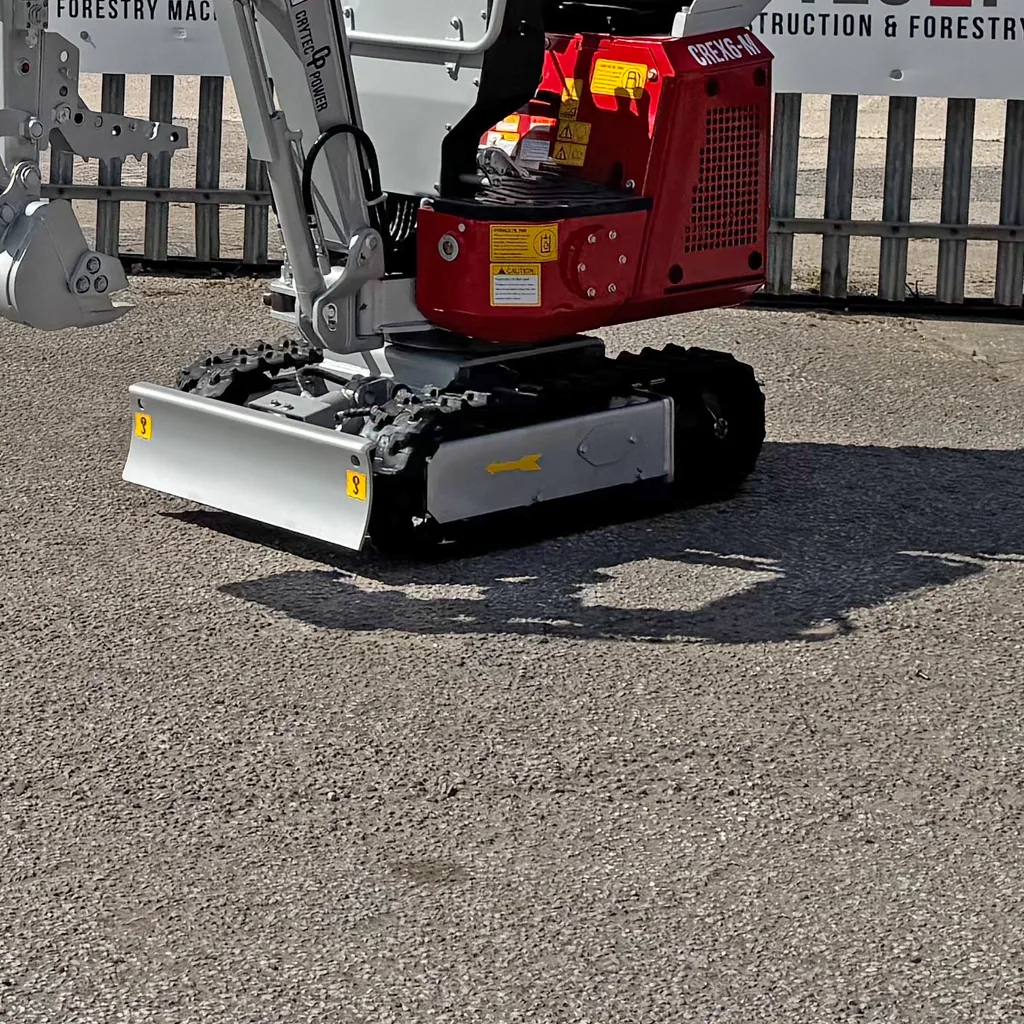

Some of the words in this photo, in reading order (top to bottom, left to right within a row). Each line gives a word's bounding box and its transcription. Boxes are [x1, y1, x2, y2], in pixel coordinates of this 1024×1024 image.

[168, 0, 217, 21] MAC
[749, 12, 872, 38] TRUCTION
[884, 15, 898, 38] &
[295, 10, 315, 55] CRYTEC
[309, 71, 328, 112] POWER
[687, 33, 762, 66] CREX6-M
